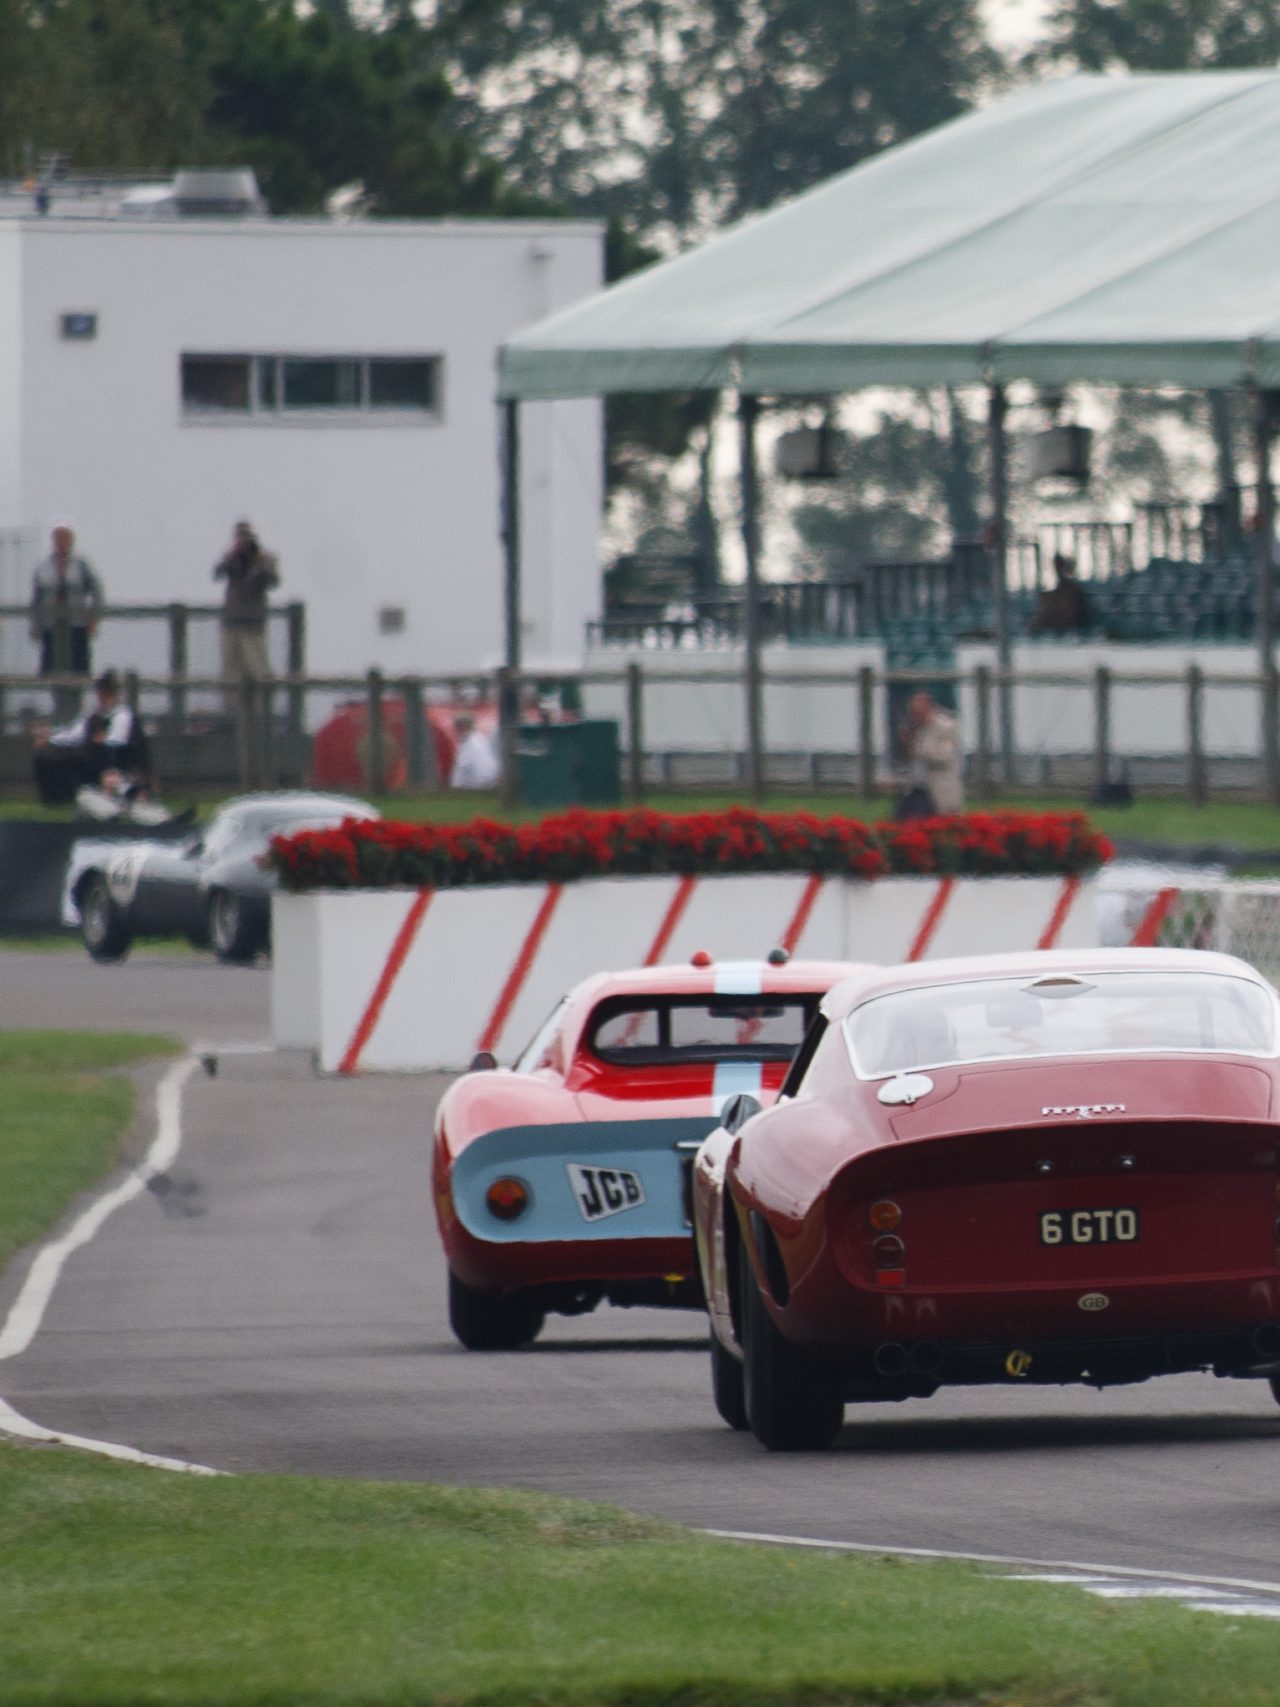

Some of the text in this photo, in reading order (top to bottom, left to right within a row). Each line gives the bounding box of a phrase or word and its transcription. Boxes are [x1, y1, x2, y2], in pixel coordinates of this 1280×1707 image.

[580, 1169, 640, 1217] JCB
[1041, 1210, 1136, 1244] 6 GTO
[1082, 1297, 1105, 1309] GB
